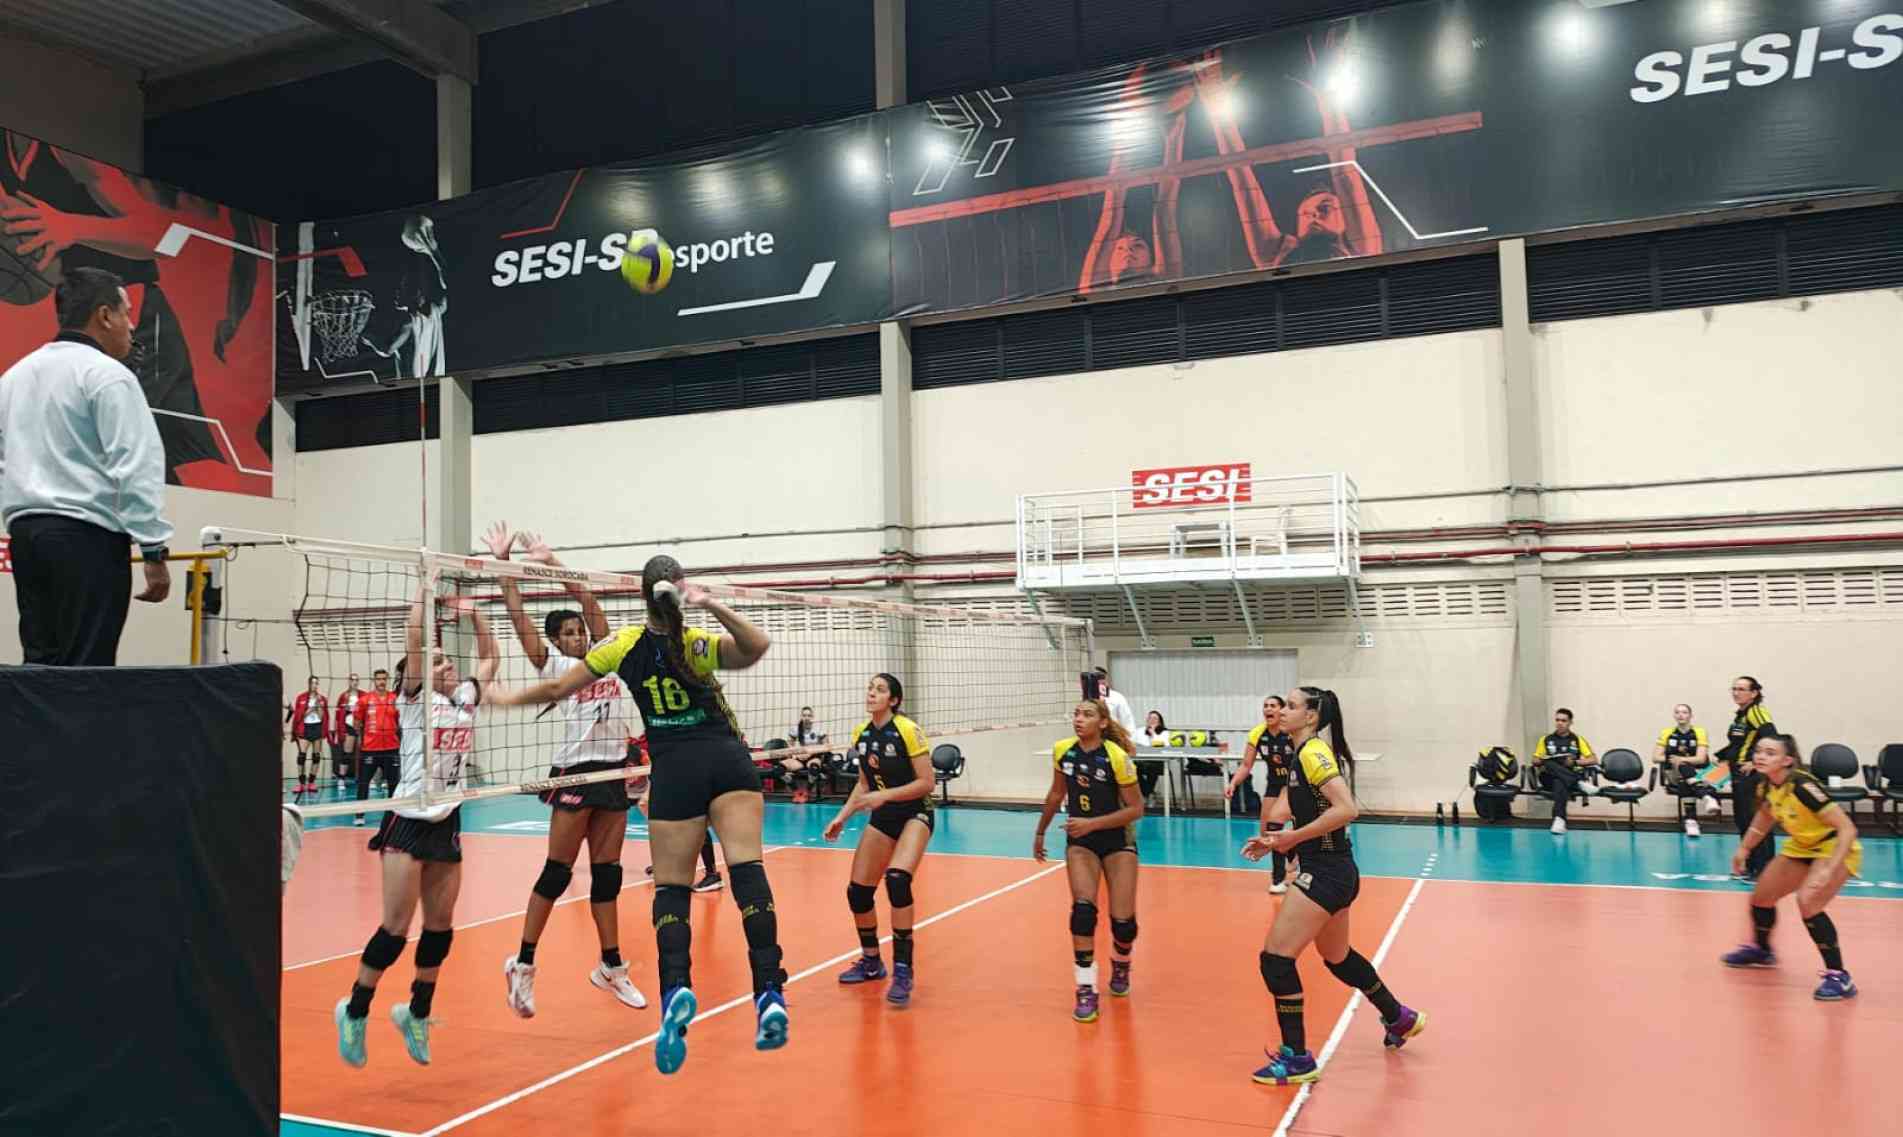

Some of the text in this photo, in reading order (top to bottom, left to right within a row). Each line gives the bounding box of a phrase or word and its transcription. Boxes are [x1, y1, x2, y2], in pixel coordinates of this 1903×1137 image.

[672, 230, 774, 273] sporte
[1142, 468, 1241, 504] SESI
[643, 675, 690, 714] 16
